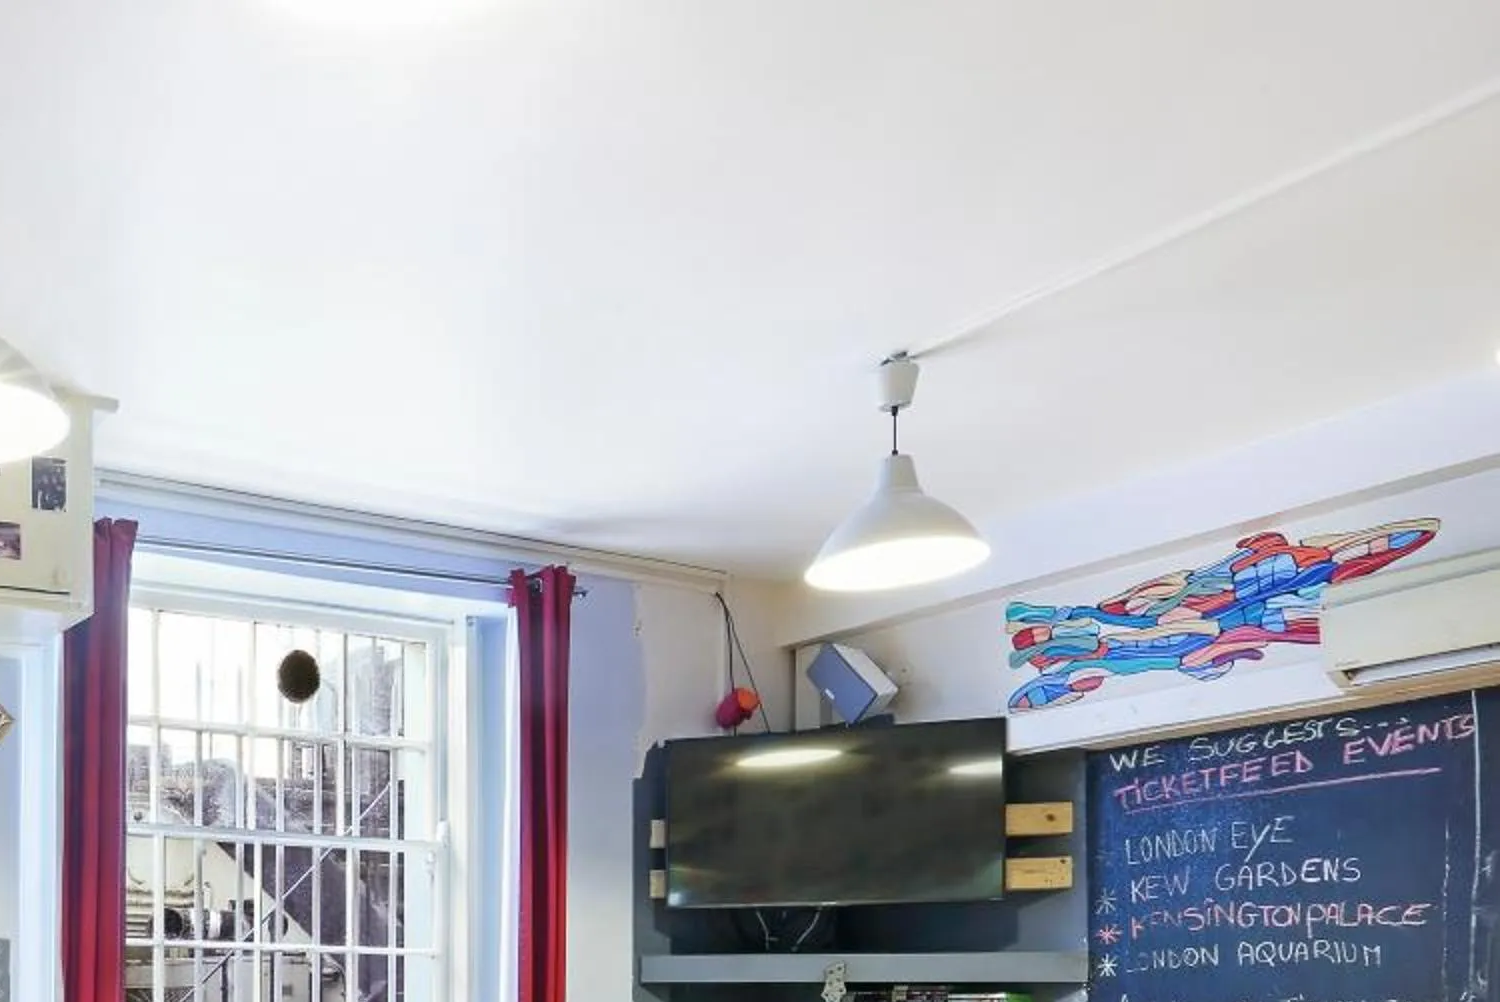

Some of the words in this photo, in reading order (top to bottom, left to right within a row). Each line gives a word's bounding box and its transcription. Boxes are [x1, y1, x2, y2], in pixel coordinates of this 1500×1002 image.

[1109, 745, 1165, 772] WE
[1124, 827, 1217, 865] LONDON
[1131, 867, 1191, 903] KEW
[1215, 857, 1362, 891] GARDENS
[1237, 939, 1382, 968] AQUARIUM
